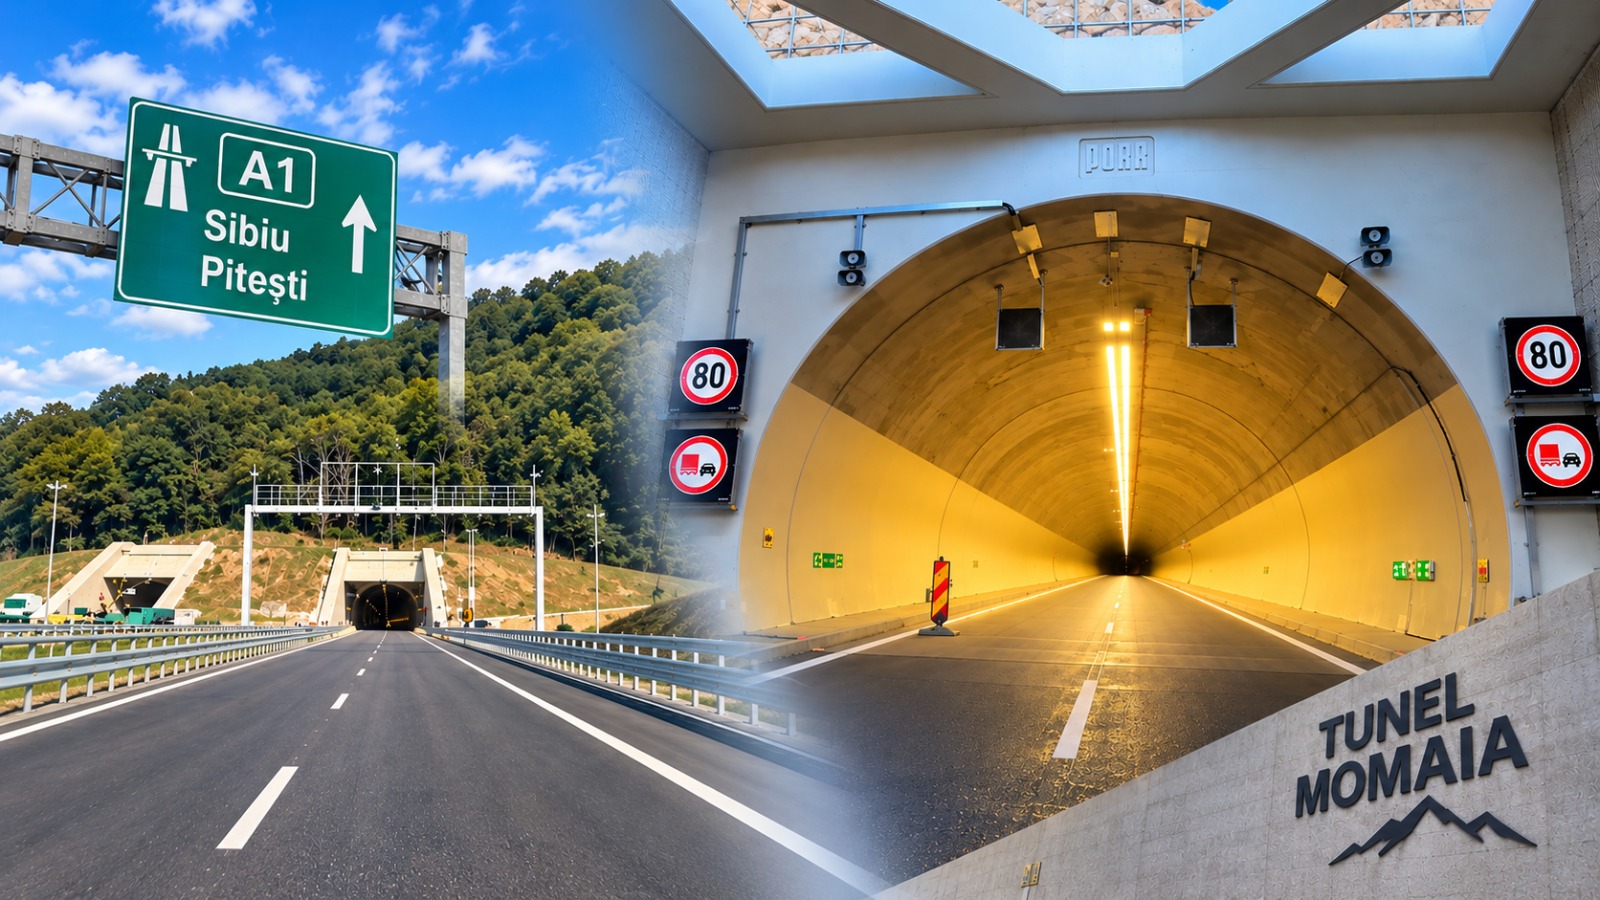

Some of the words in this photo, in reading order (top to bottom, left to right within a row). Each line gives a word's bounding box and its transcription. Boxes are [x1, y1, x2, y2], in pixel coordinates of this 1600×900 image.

[238, 150, 294, 193] A1
[1085, 142, 1148, 174] PORR
[204, 209, 290, 253] Sibiu
[692, 362, 726, 389] 80
[1530, 340, 1567, 369] 80
[1319, 671, 1475, 759] TUNEL
[1295, 714, 1529, 818] MOMAIA
